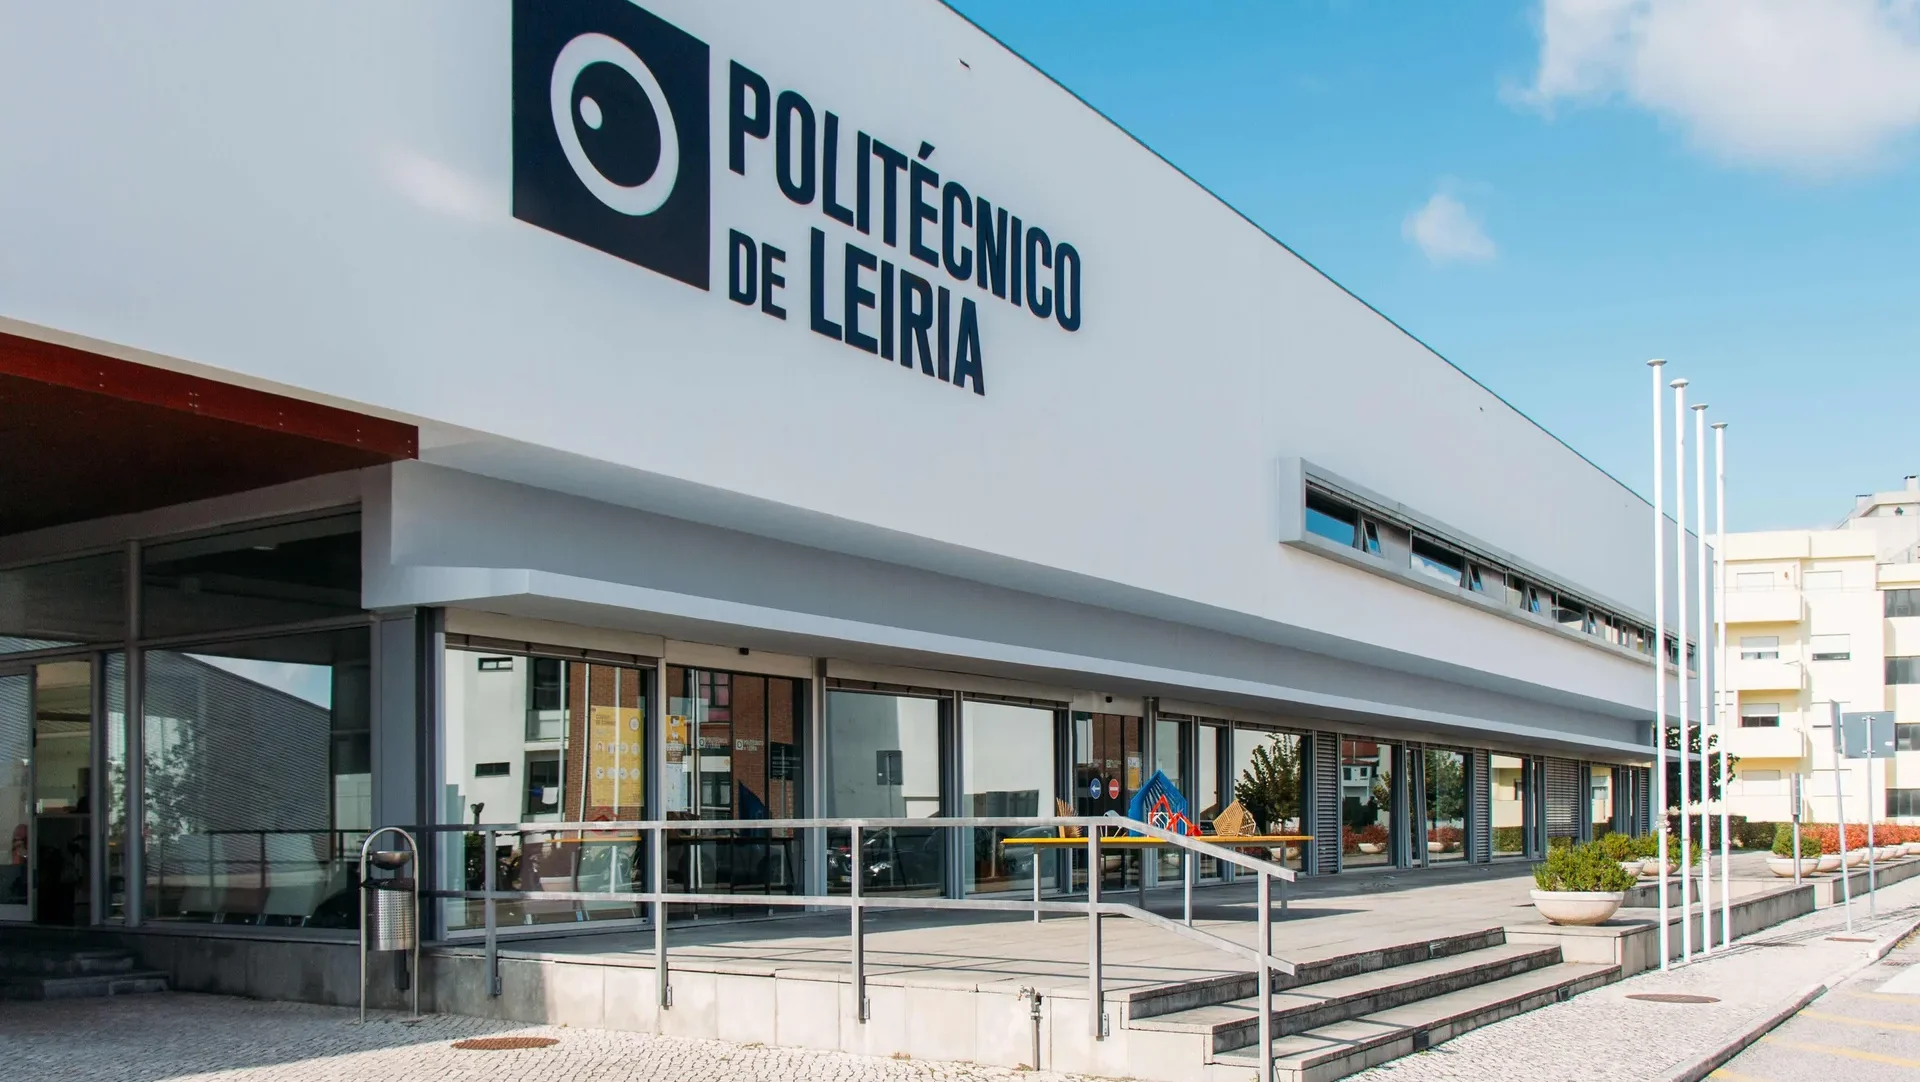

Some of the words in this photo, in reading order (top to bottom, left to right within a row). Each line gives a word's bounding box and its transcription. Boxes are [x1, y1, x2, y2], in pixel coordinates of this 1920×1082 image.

[728, 59, 1081, 332] POLITÉCNICO
[728, 227, 787, 321] DE
[809, 226, 986, 397] LEIRIA
